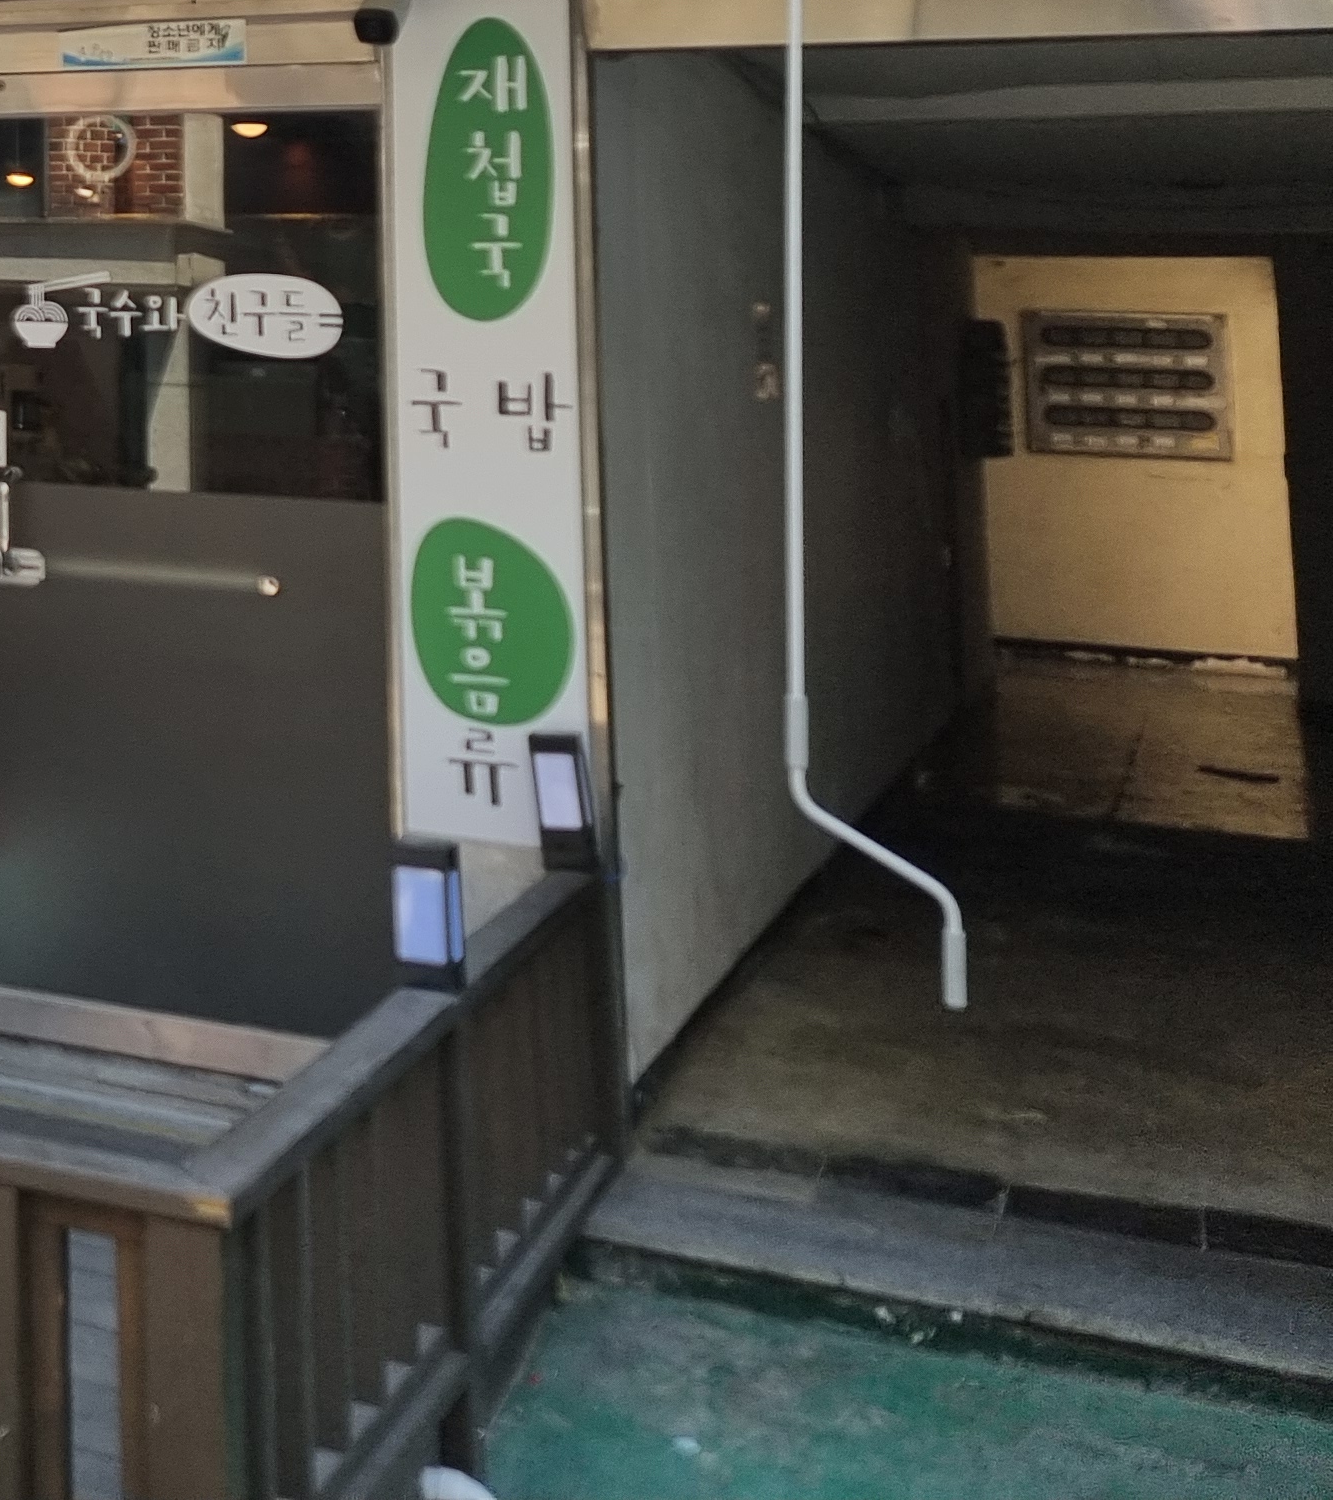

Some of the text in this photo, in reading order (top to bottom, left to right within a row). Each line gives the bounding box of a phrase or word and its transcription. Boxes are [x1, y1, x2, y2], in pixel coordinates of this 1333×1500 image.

[458, 55, 526, 290] 재첩국
[77, 287, 309, 341] 국수와 친구들
